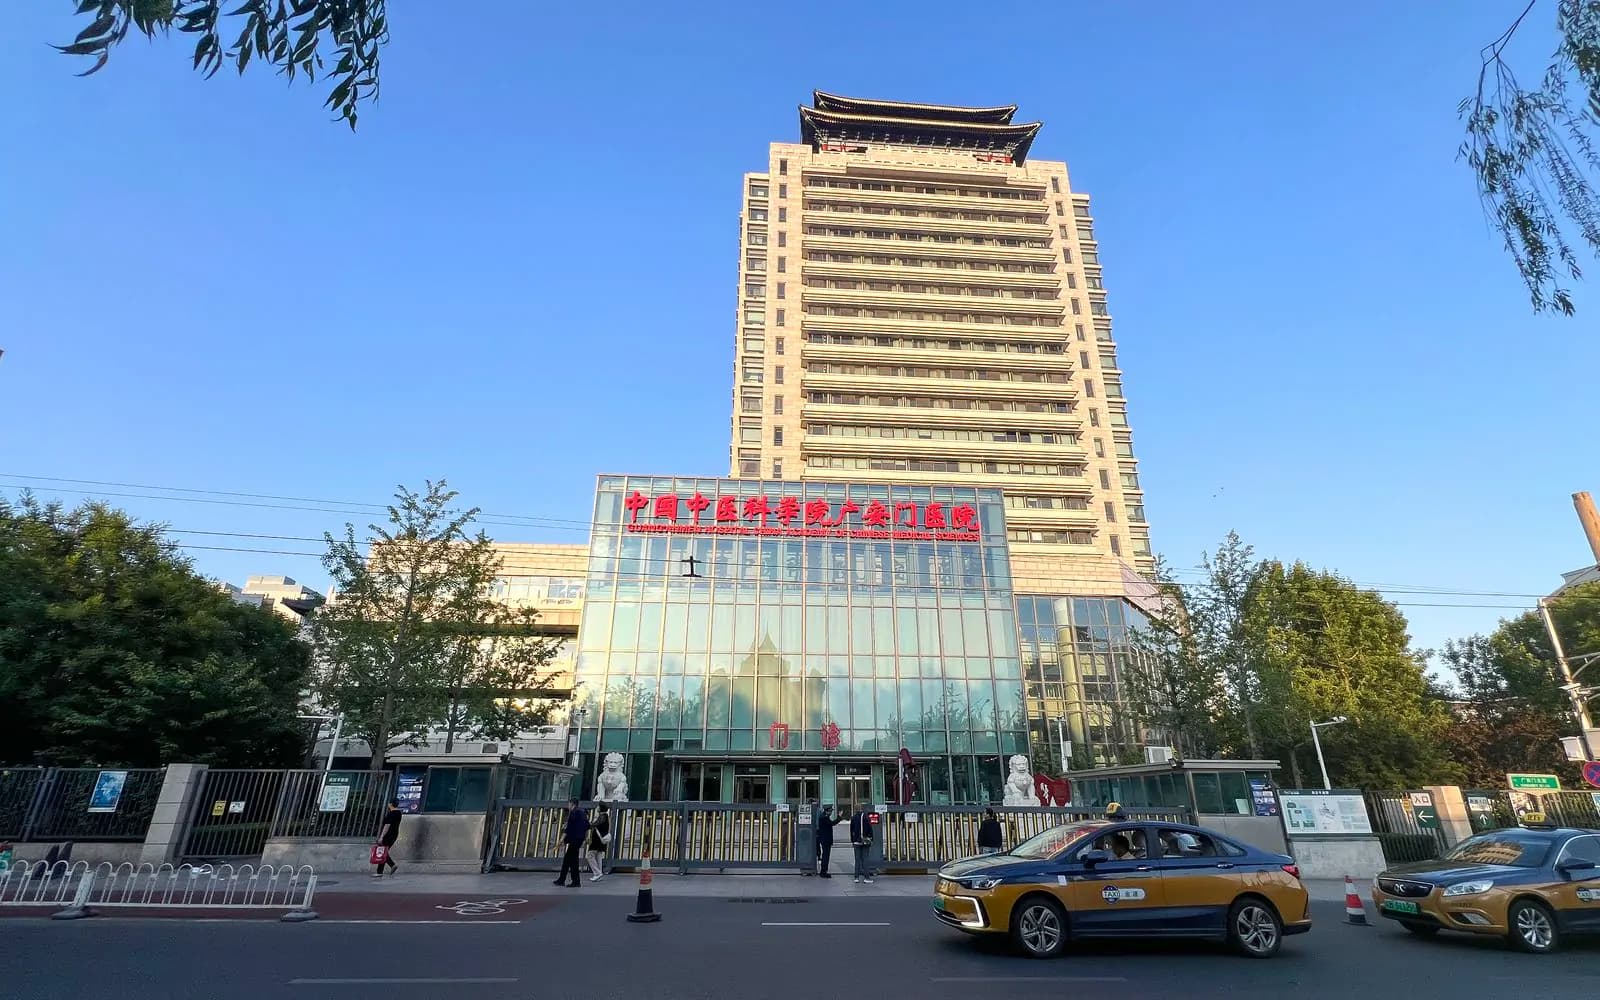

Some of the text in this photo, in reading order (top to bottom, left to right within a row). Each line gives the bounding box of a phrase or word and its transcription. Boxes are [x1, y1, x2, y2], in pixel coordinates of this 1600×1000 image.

[624, 490, 980, 531] 中国中医科学院广安门医院
[836, 529, 848, 538] OF
[851, 529, 889, 539] CHINESE
[893, 531, 931, 541] MEDICAL
[936, 532, 980, 542] SCIENCES
[769, 721, 841, 748] 门诊
[1414, 795, 1429, 804] 入口
